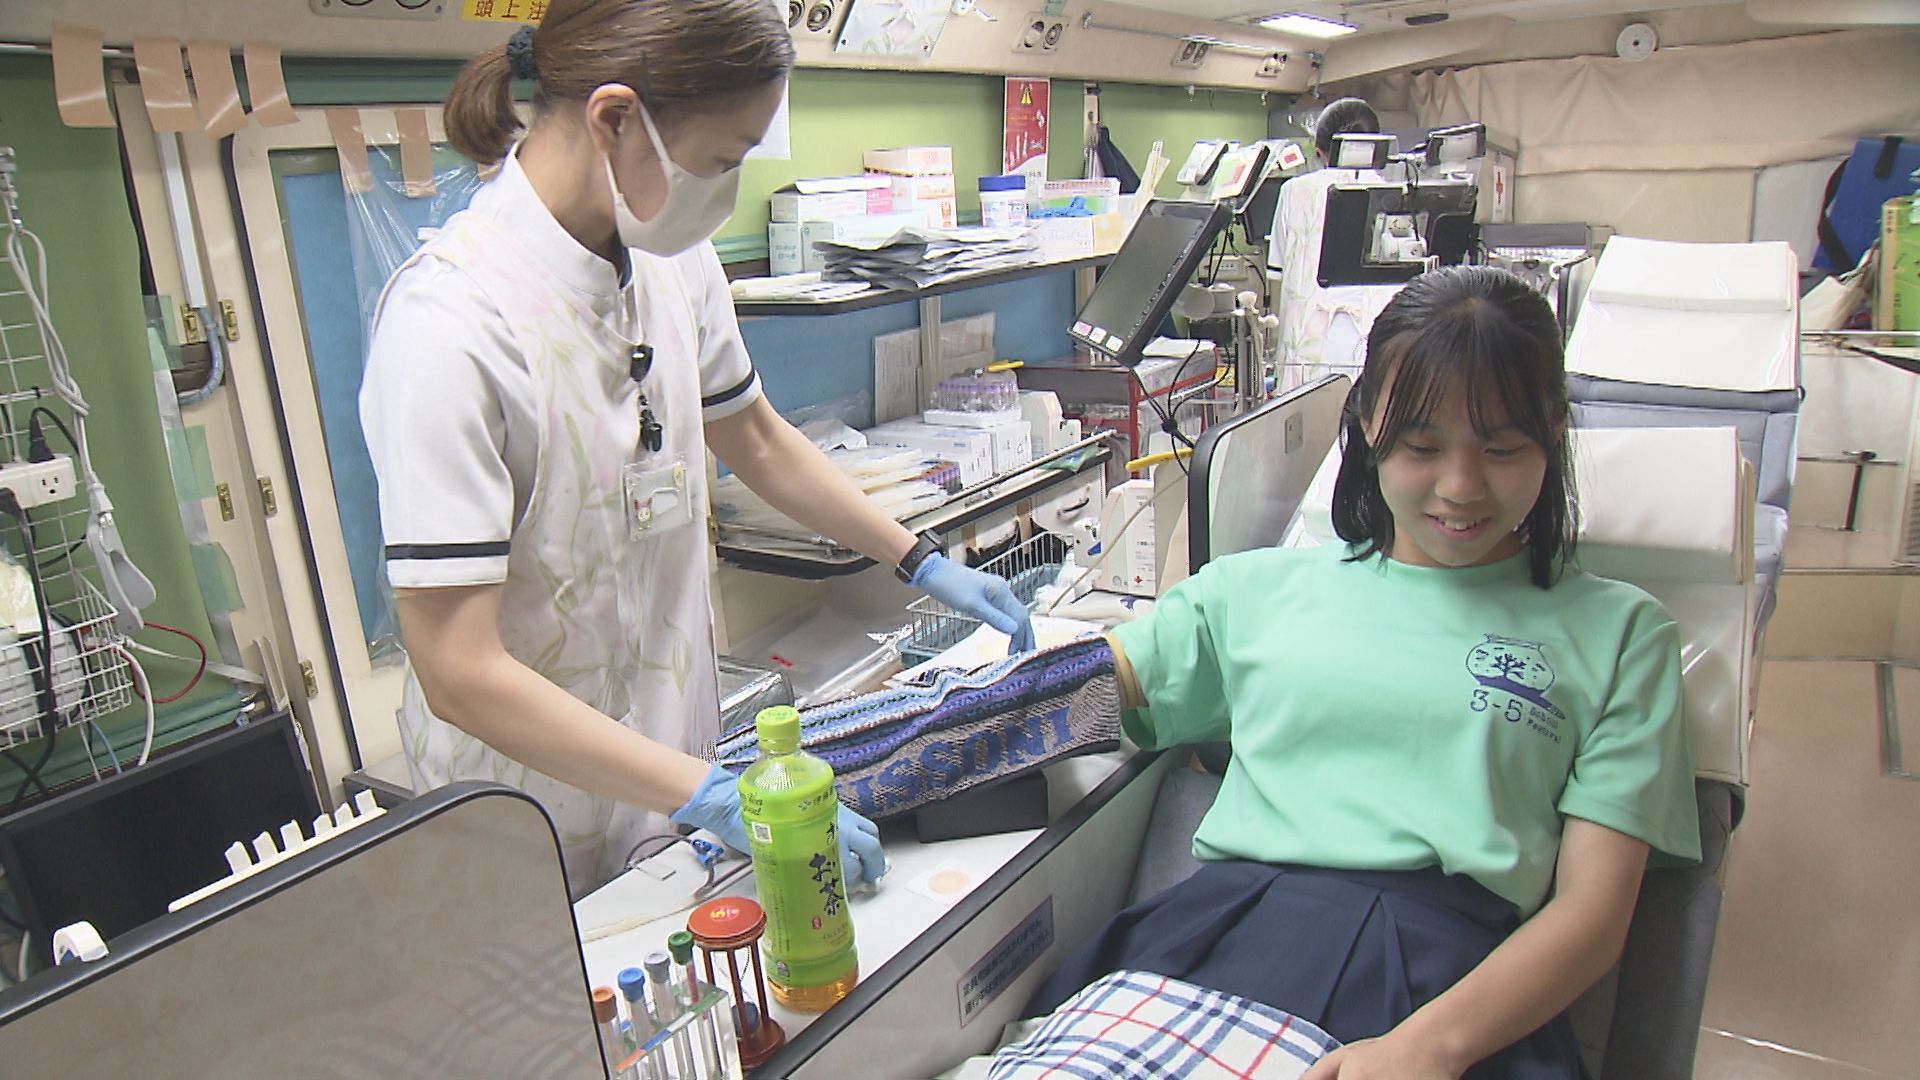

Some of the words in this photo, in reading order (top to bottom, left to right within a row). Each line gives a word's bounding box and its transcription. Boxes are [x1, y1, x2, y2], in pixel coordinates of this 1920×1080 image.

[1470, 689, 1523, 722] 3-5
[836, 706, 1074, 814] ISSONI
[809, 853, 844, 915] お茶
